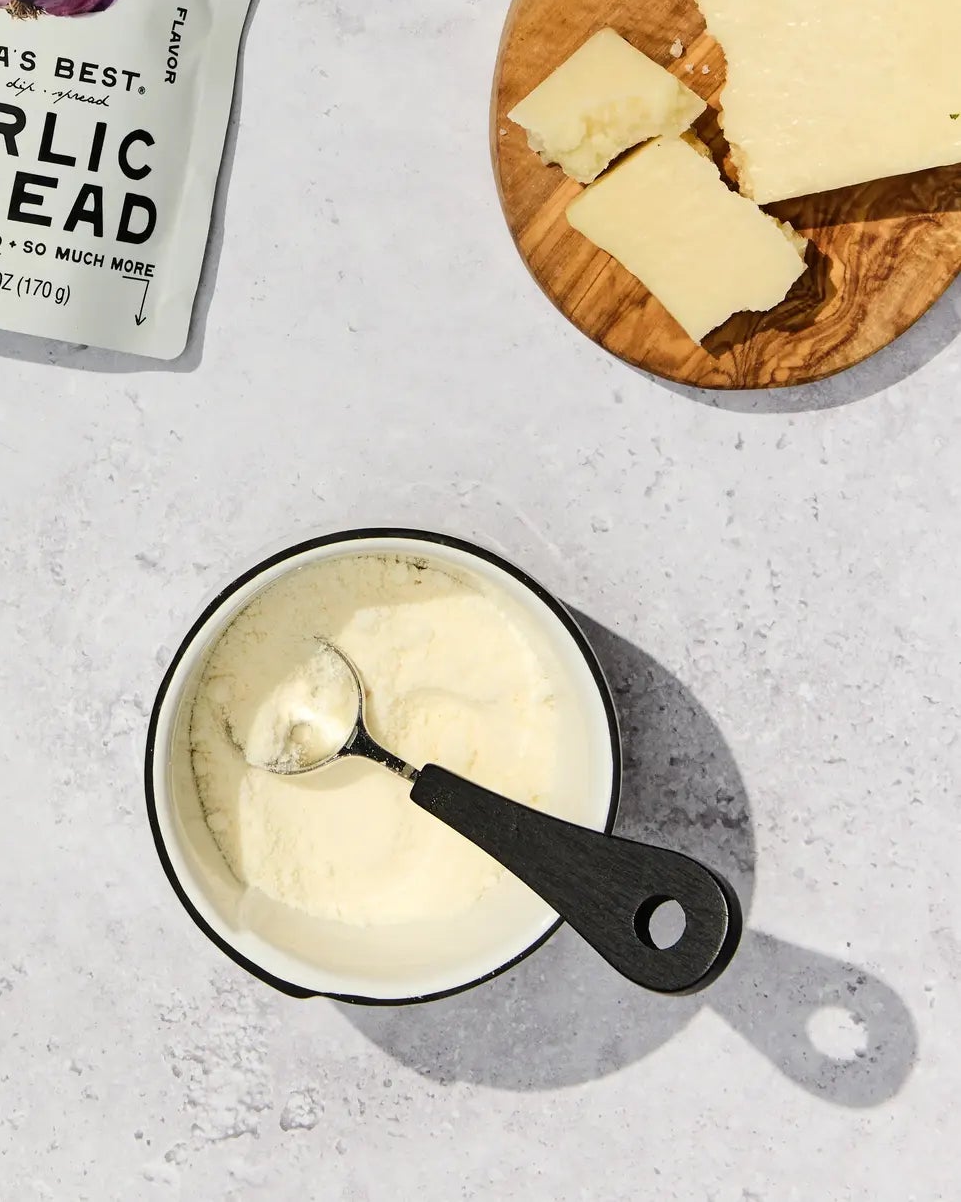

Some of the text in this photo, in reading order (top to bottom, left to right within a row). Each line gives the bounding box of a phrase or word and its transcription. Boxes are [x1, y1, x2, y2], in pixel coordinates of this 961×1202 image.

[163, 6, 189, 85] FLAVOR
[5, 77, 36, 97] dip
[51, 88, 110, 108] spread
[22, 240, 47, 256] SO
[54, 245, 106, 268] MUCH
[110, 256, 156, 278] MORE
[16, 276, 53, 299] (170
[54, 284, 71, 307] g)
